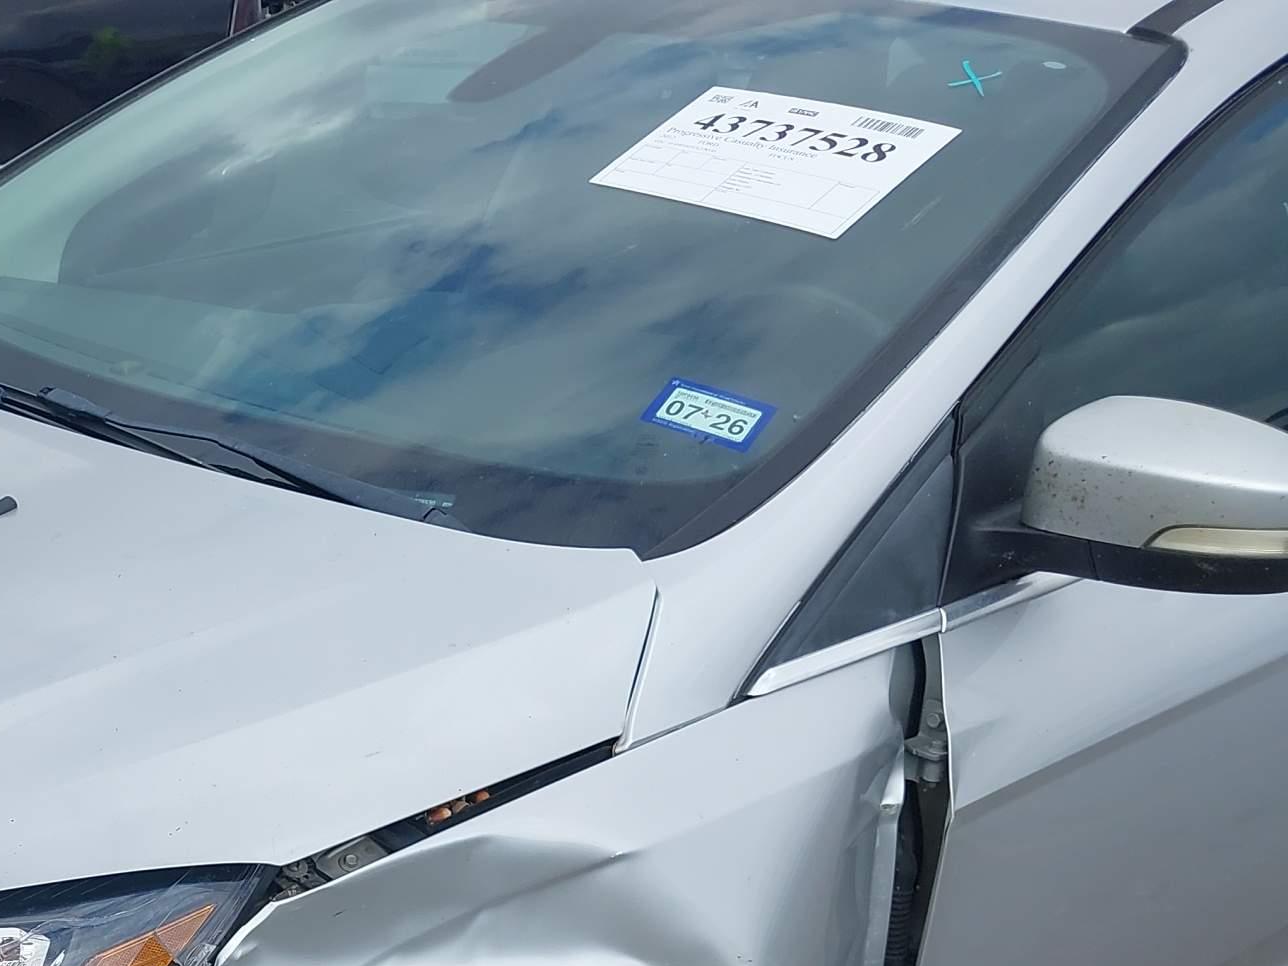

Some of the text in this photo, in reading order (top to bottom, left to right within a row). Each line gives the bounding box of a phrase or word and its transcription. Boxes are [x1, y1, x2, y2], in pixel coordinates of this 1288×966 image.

[666, 126, 723, 141] Progressive
[723, 136, 766, 150] Casualty
[768, 144, 818, 159] Insurance
[693, 113, 897, 163] 43737528
[665, 400, 704, 420] 07
[709, 413, 748, 436] 26
